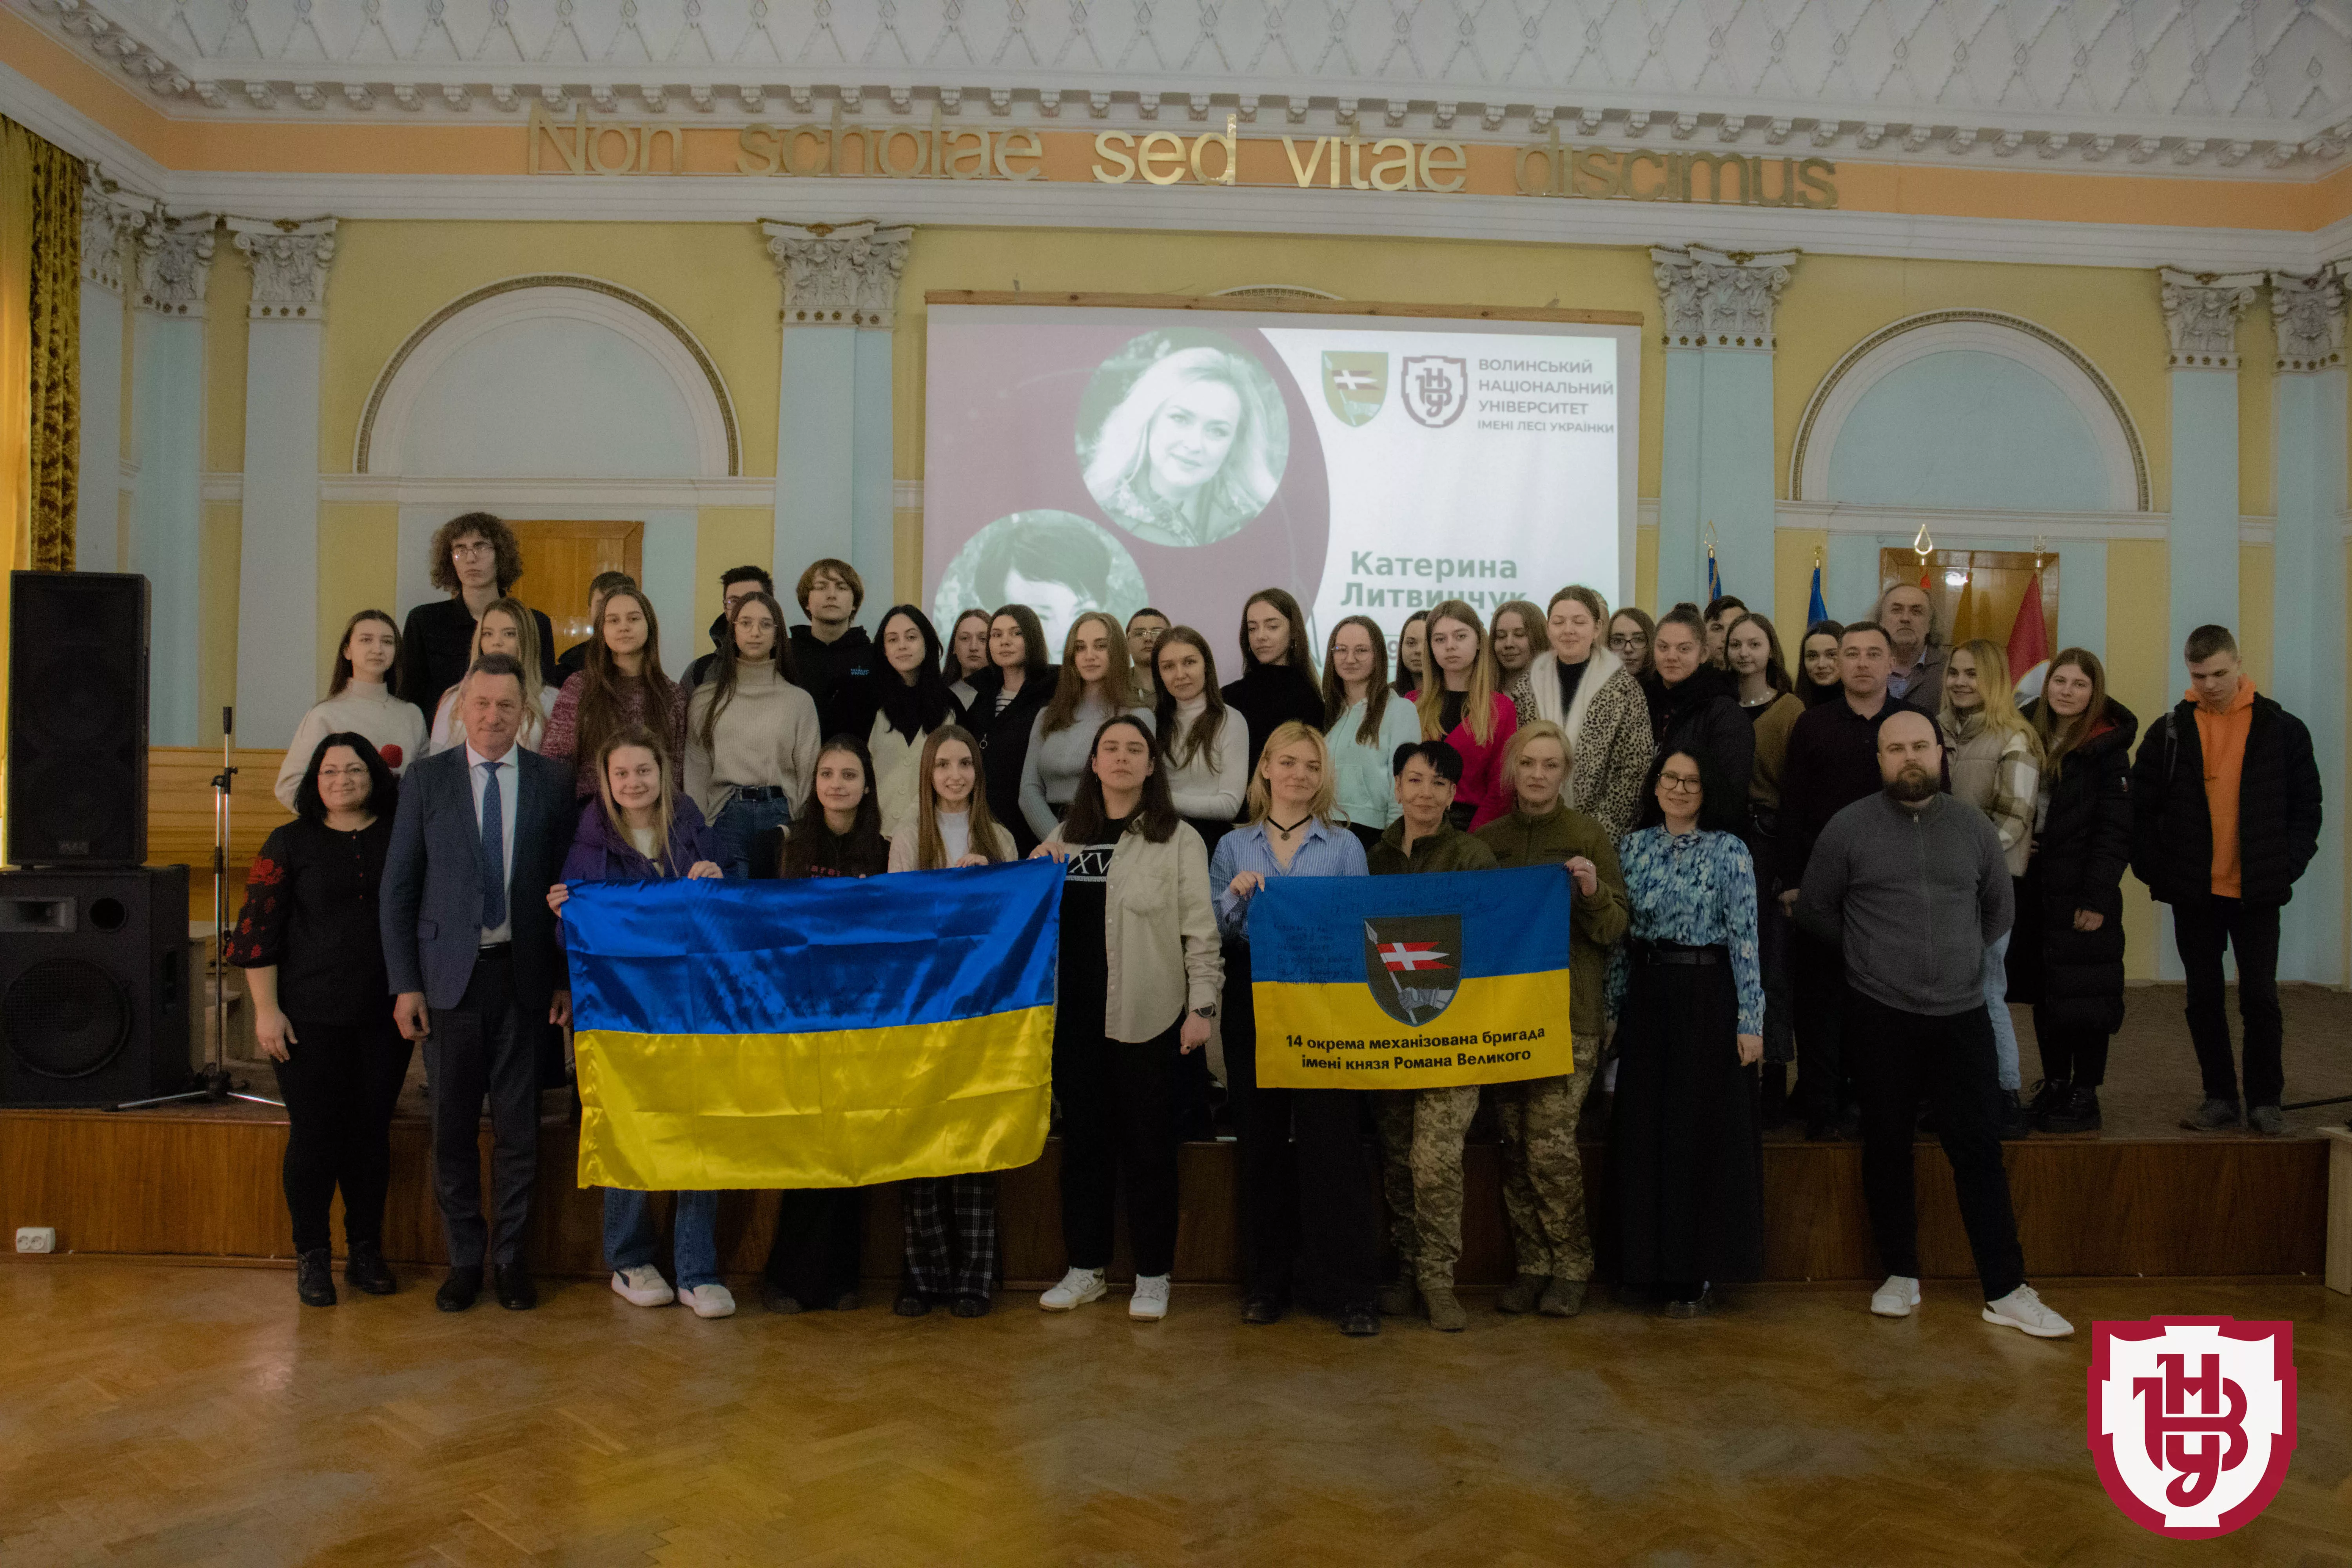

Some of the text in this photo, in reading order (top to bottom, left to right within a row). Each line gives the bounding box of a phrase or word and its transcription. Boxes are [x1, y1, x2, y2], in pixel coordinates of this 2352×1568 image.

[529, 99, 1839, 209] Non scholae sed vitae discimus
[1478, 359, 1593, 374] ВОЛИНСЬКИЙ
[1478, 379, 1614, 395] НАЦІОНАЛЬНИЙ
[1478, 400, 1589, 415] УНІВЕРСИТЕТ
[1477, 420, 1614, 433] ІМЕНІ ЛЕСІ УКРАЇНКИ
[1351, 551, 1517, 583] Катерина
[1286, 1028, 1545, 1053] 14 окрема механізована бригада
[1301, 1050, 1531, 1070] імені князя Романа Великого
